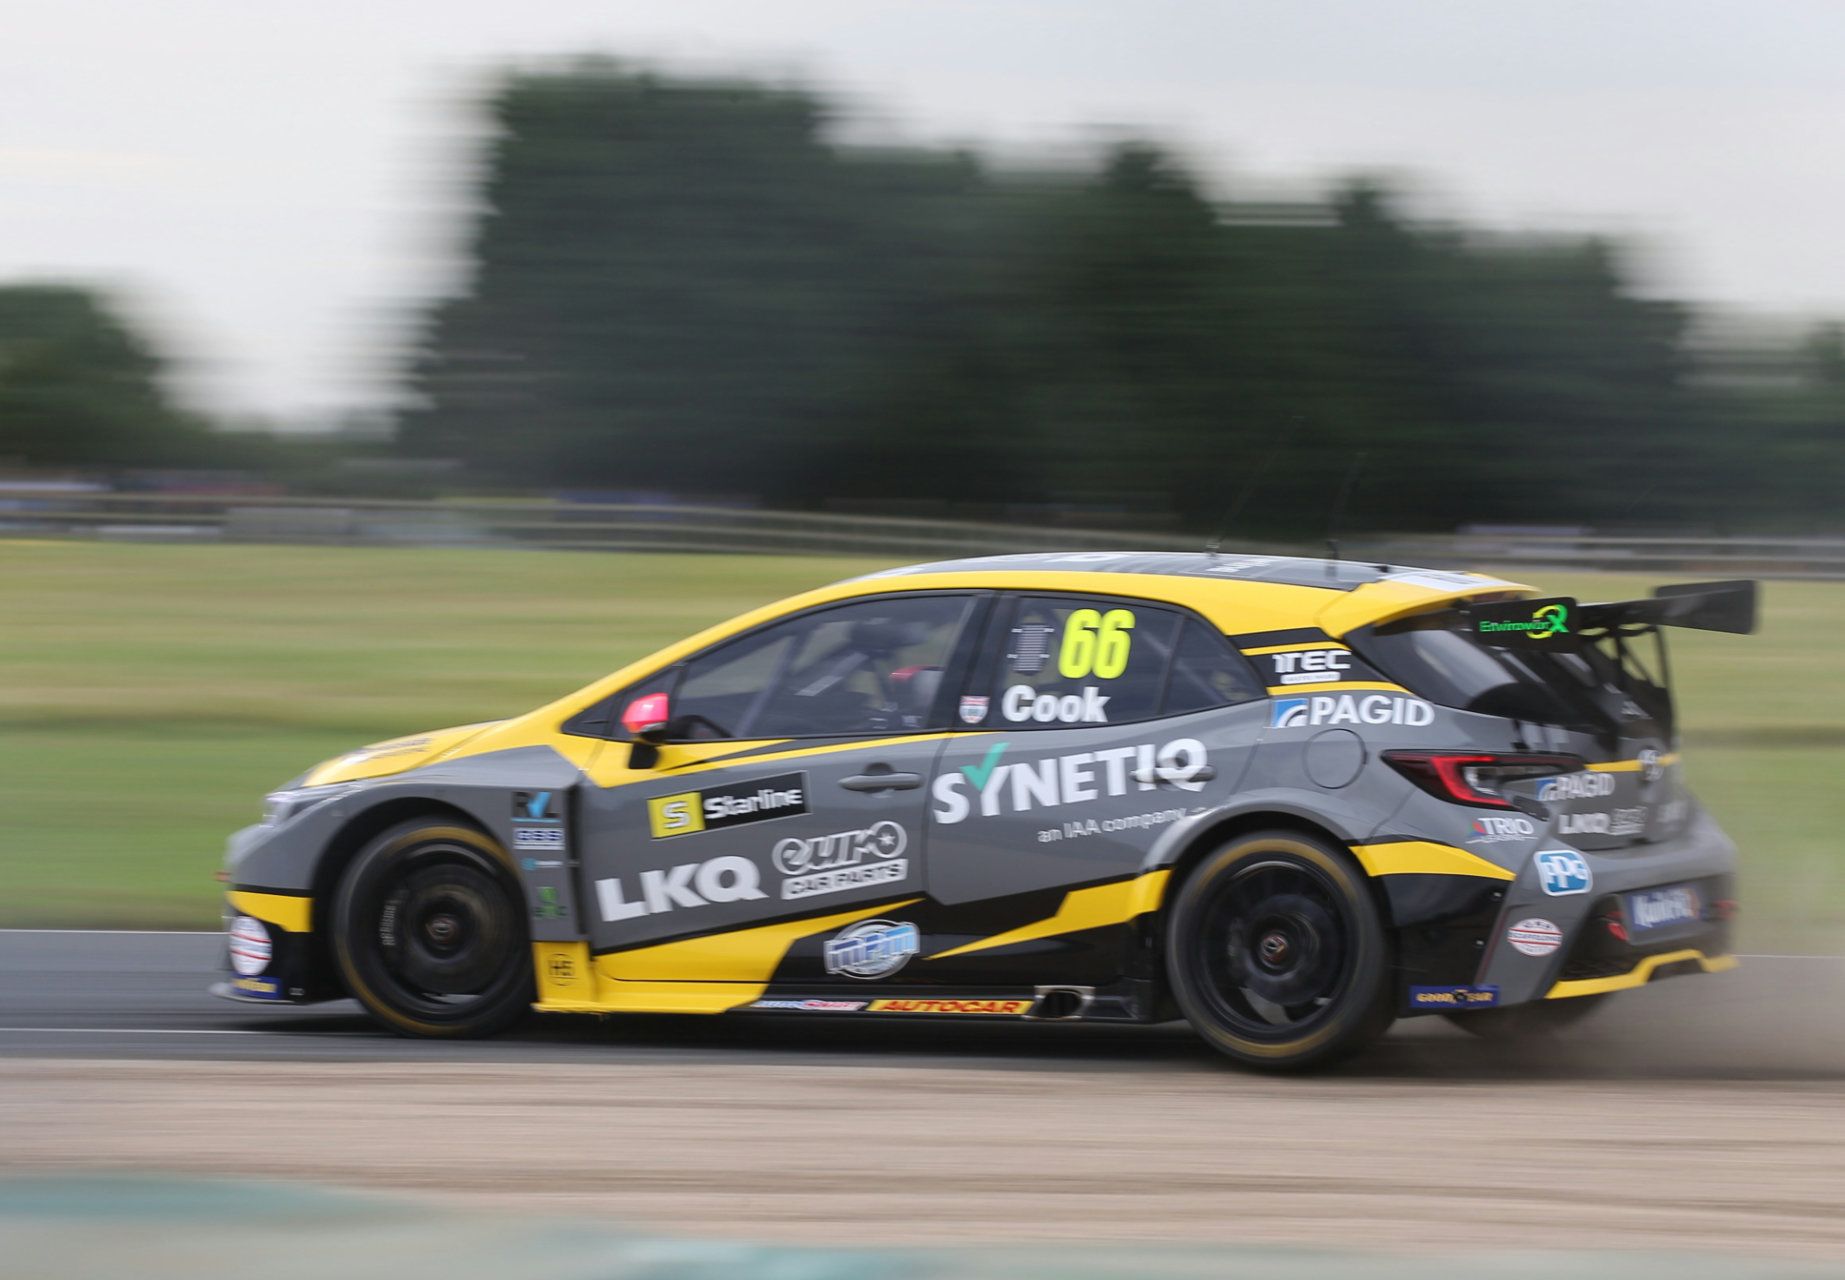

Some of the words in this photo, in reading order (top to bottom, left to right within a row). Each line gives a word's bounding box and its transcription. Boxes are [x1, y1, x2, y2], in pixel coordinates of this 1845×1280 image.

[1058, 608, 1136, 679] 66
[1001, 684, 1111, 723] Cook
[1310, 694, 1435, 727] PAGID
[932, 738, 1209, 825] SYNETIQ
[703, 787, 804, 820] Starline
[1477, 816, 1535, 835] TRIO
[771, 820, 909, 877] euro
[594, 855, 769, 923] LKQ
[880, 1000, 1023, 1014] AUTOCAR
